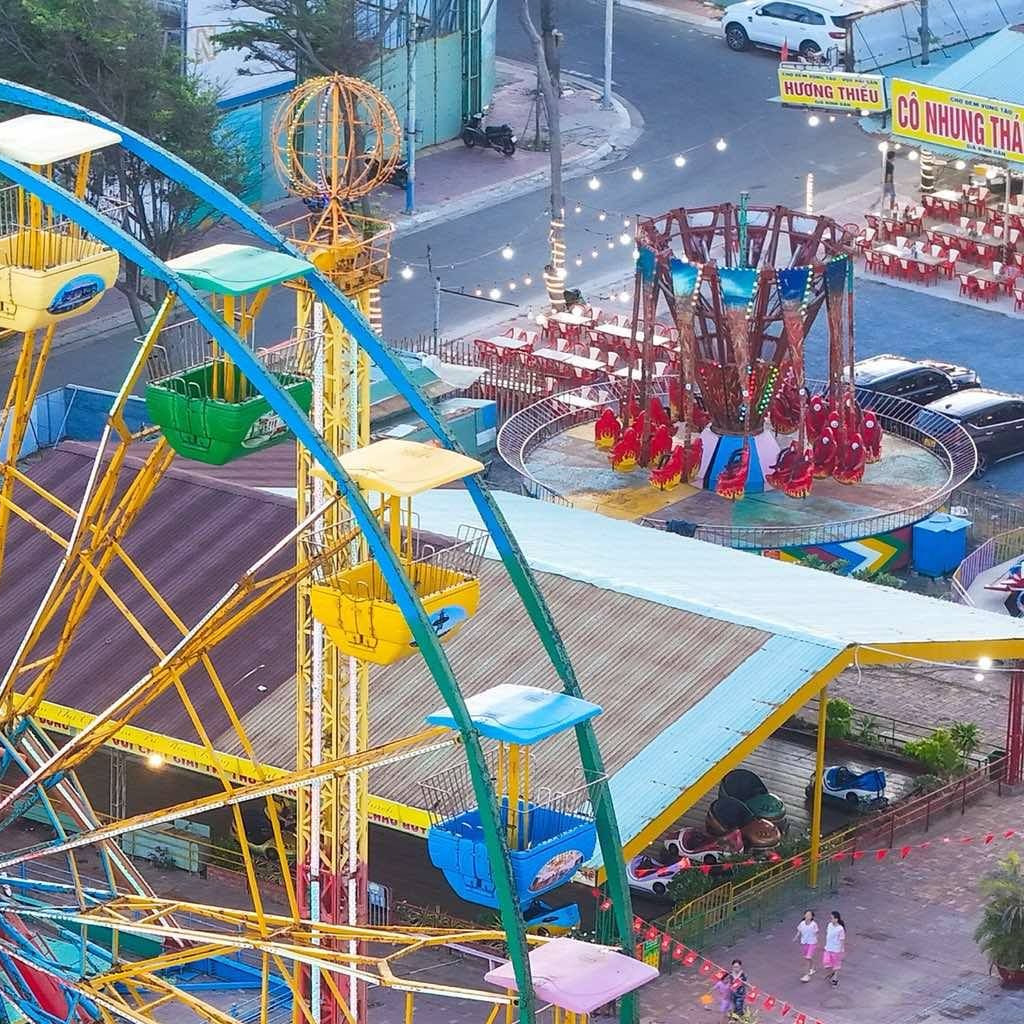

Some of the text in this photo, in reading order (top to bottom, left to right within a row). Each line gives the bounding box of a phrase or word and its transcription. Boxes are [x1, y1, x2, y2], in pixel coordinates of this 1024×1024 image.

[784, 81, 834, 99] HƯƠNG
[898, 91, 920, 130] CÔ
[925, 101, 984, 145] NHUNG
